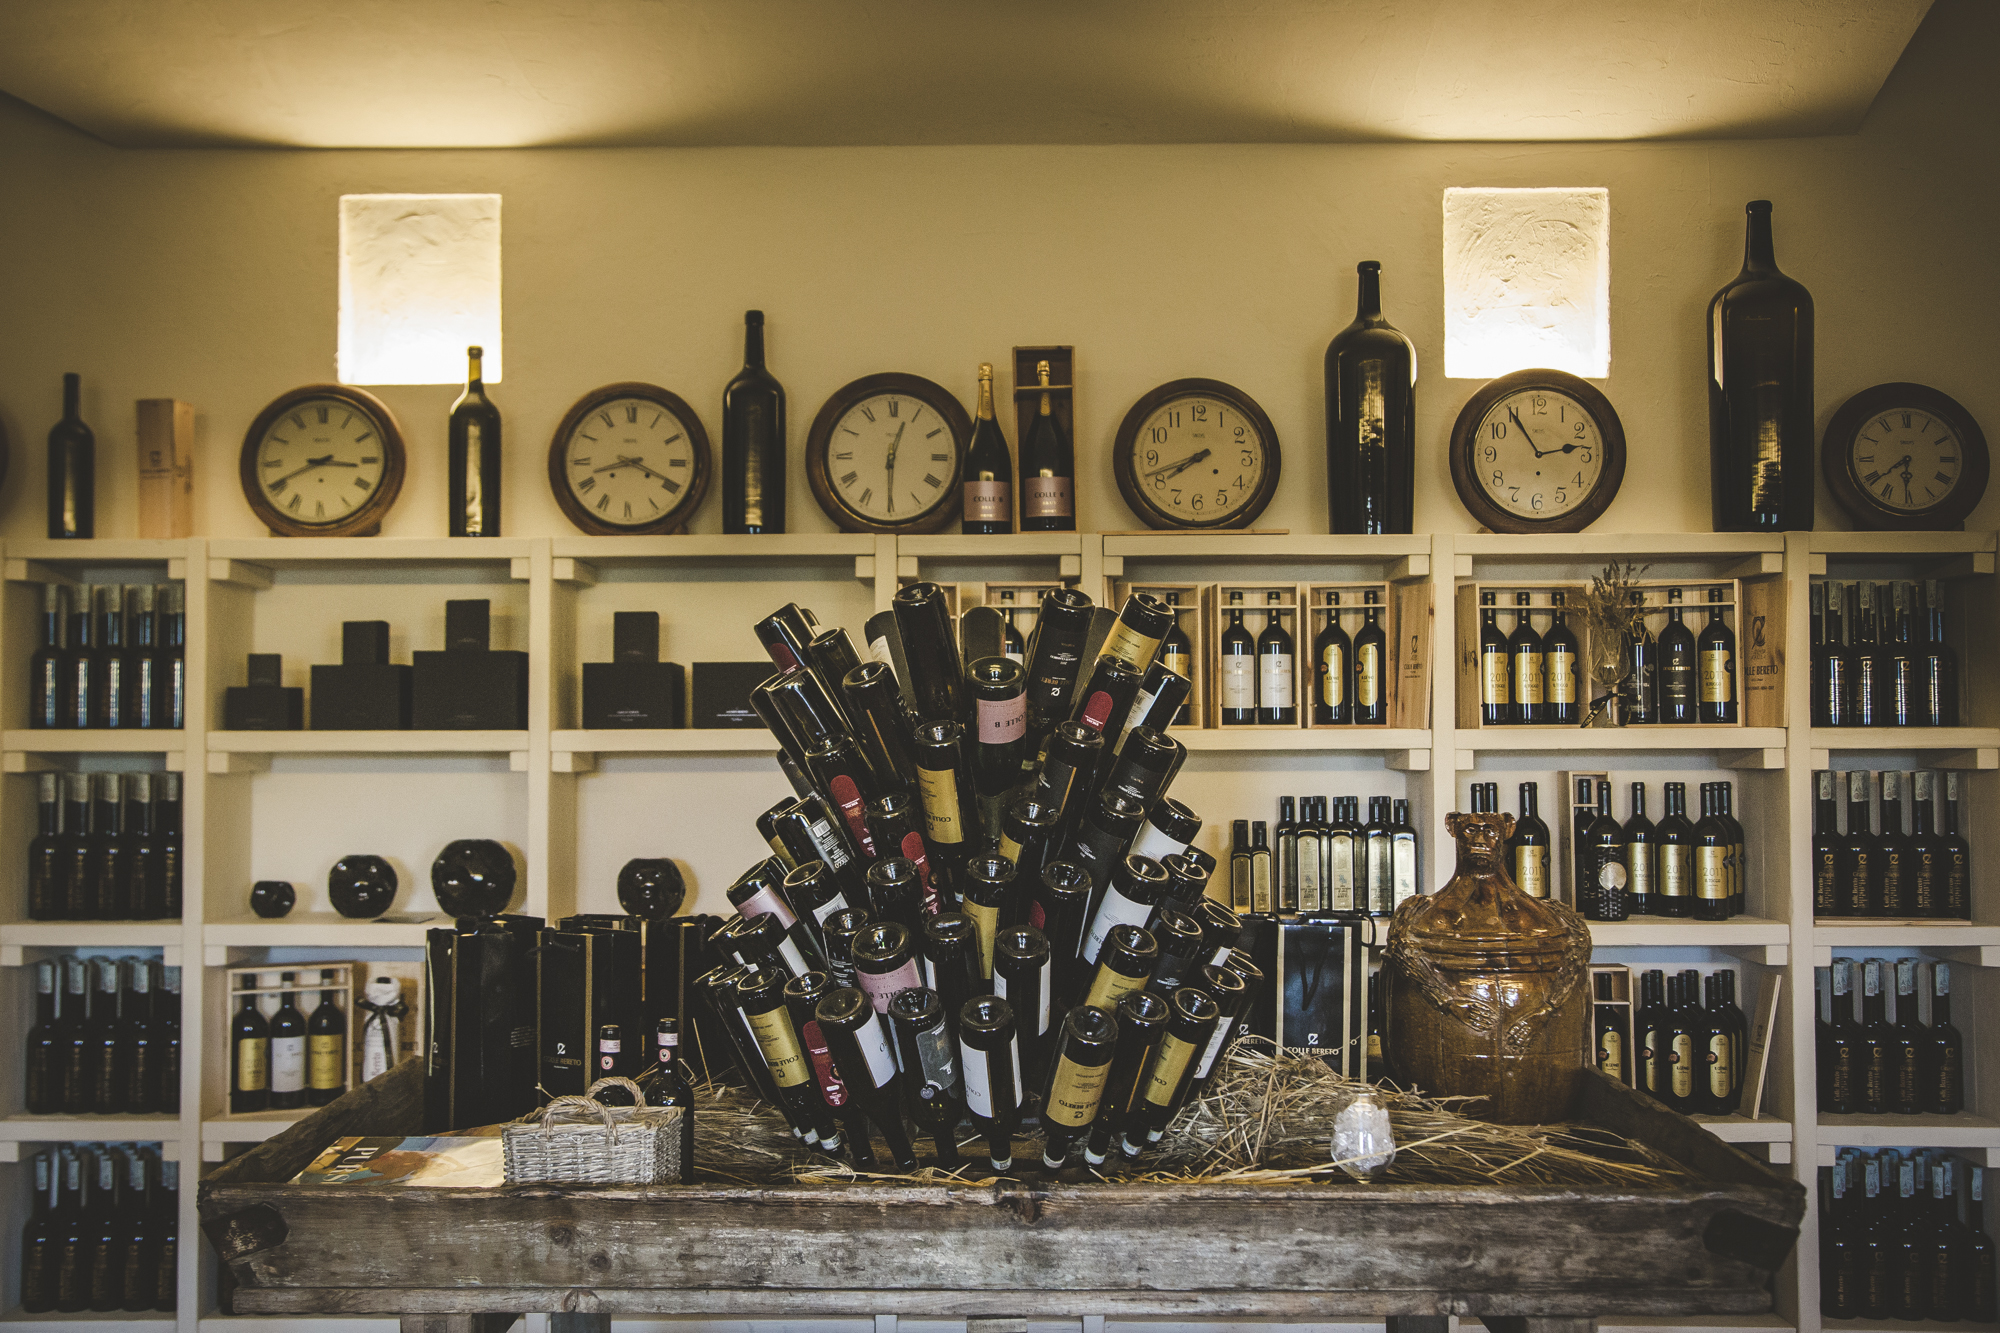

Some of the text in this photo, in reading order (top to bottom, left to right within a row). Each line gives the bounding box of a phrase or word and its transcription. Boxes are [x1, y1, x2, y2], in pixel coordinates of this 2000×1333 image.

[1192, 404, 1208, 422] 12
[1532, 398, 1548, 416] 12
[1560, 406, 1564, 422] 1
[1169, 412, 1180, 428] 11
[1220, 411, 1223, 428] 1
[1152, 426, 1168, 444] 10
[1234, 426, 1246, 444] 2
[1491, 422, 1506, 440] 10
[1574, 422, 1586, 440] 2
[1146, 450, 1158, 466] 9
[1241, 450, 1253, 466] 3
[1484, 446, 1497, 463] 9
[1580, 446, 1592, 463] 3
[1154, 473, 1166, 490] 8
[1232, 474, 1246, 490] 4
[1492, 470, 1504, 487] 8
[1572, 471, 1584, 488] 4
[1170, 489, 1182, 505] 7
[1192, 494, 1204, 510] 6
[1216, 490, 1228, 506] 5
[1508, 486, 1520, 502] 7
[1532, 493, 1543, 510] 6
[1554, 486, 1566, 504] 5
[1490, 672, 1506, 682] 2011
[1552, 672, 1572, 682] 2011
[1704, 670, 1724, 680] 2011
[1756, 664, 1778, 675] BERETO
[1040, 677, 1058, 686] BERET
[1005, 712, 1026, 727] OLLE
[1522, 866, 1542, 876] 2011
[1633, 862, 1652, 872] 201
[1702, 867, 1722, 876] 2011
[1288, 1046, 1340, 1056] COLLE BERETO
[560, 1057, 582, 1066] BERETO
[779, 1055, 800, 1066] COLLE
[1058, 1100, 1084, 1110] BERETO
[320, 1146, 380, 1184] PURS
